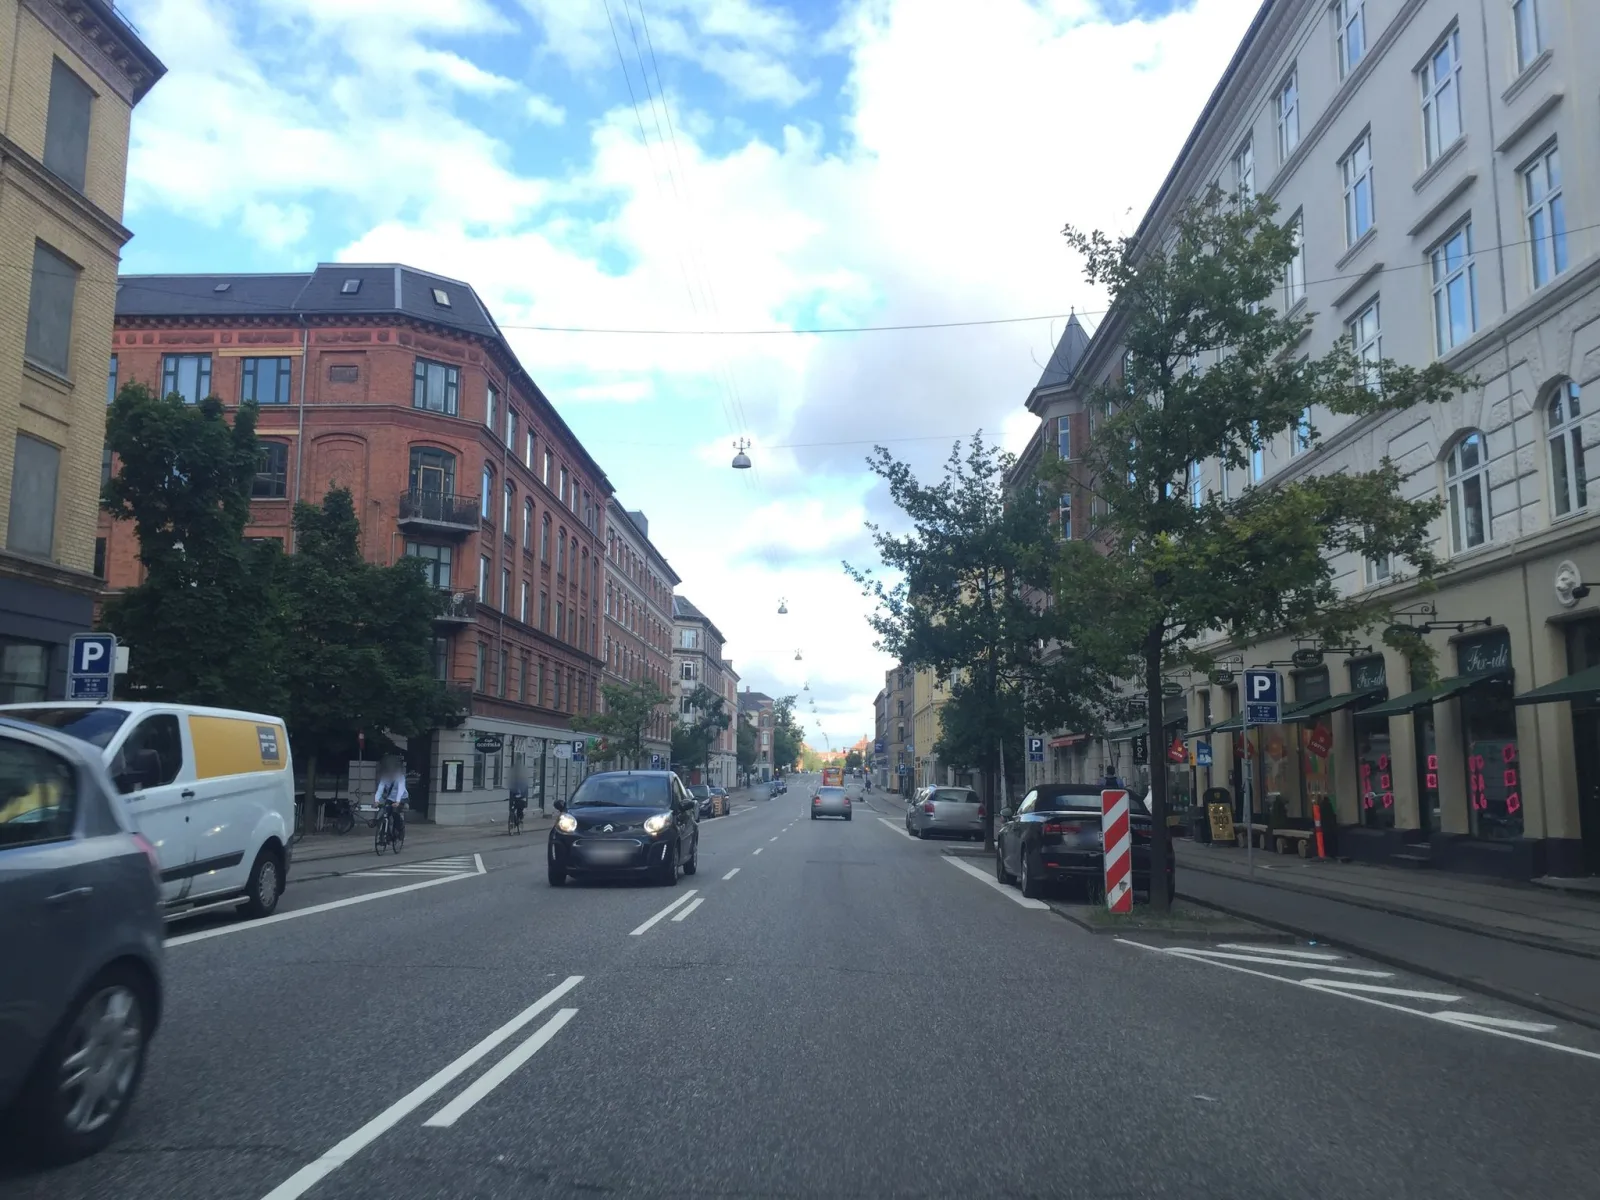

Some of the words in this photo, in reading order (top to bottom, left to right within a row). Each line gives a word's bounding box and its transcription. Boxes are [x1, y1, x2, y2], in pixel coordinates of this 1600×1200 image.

[82, 642, 104, 670] P
[1254, 675, 1270, 699] P
[575, 741, 583, 752] P
[1032, 740, 1041, 751] P
[1311, 741, 1326, 752] LOTTO
[653, 755, 658, 763] P
